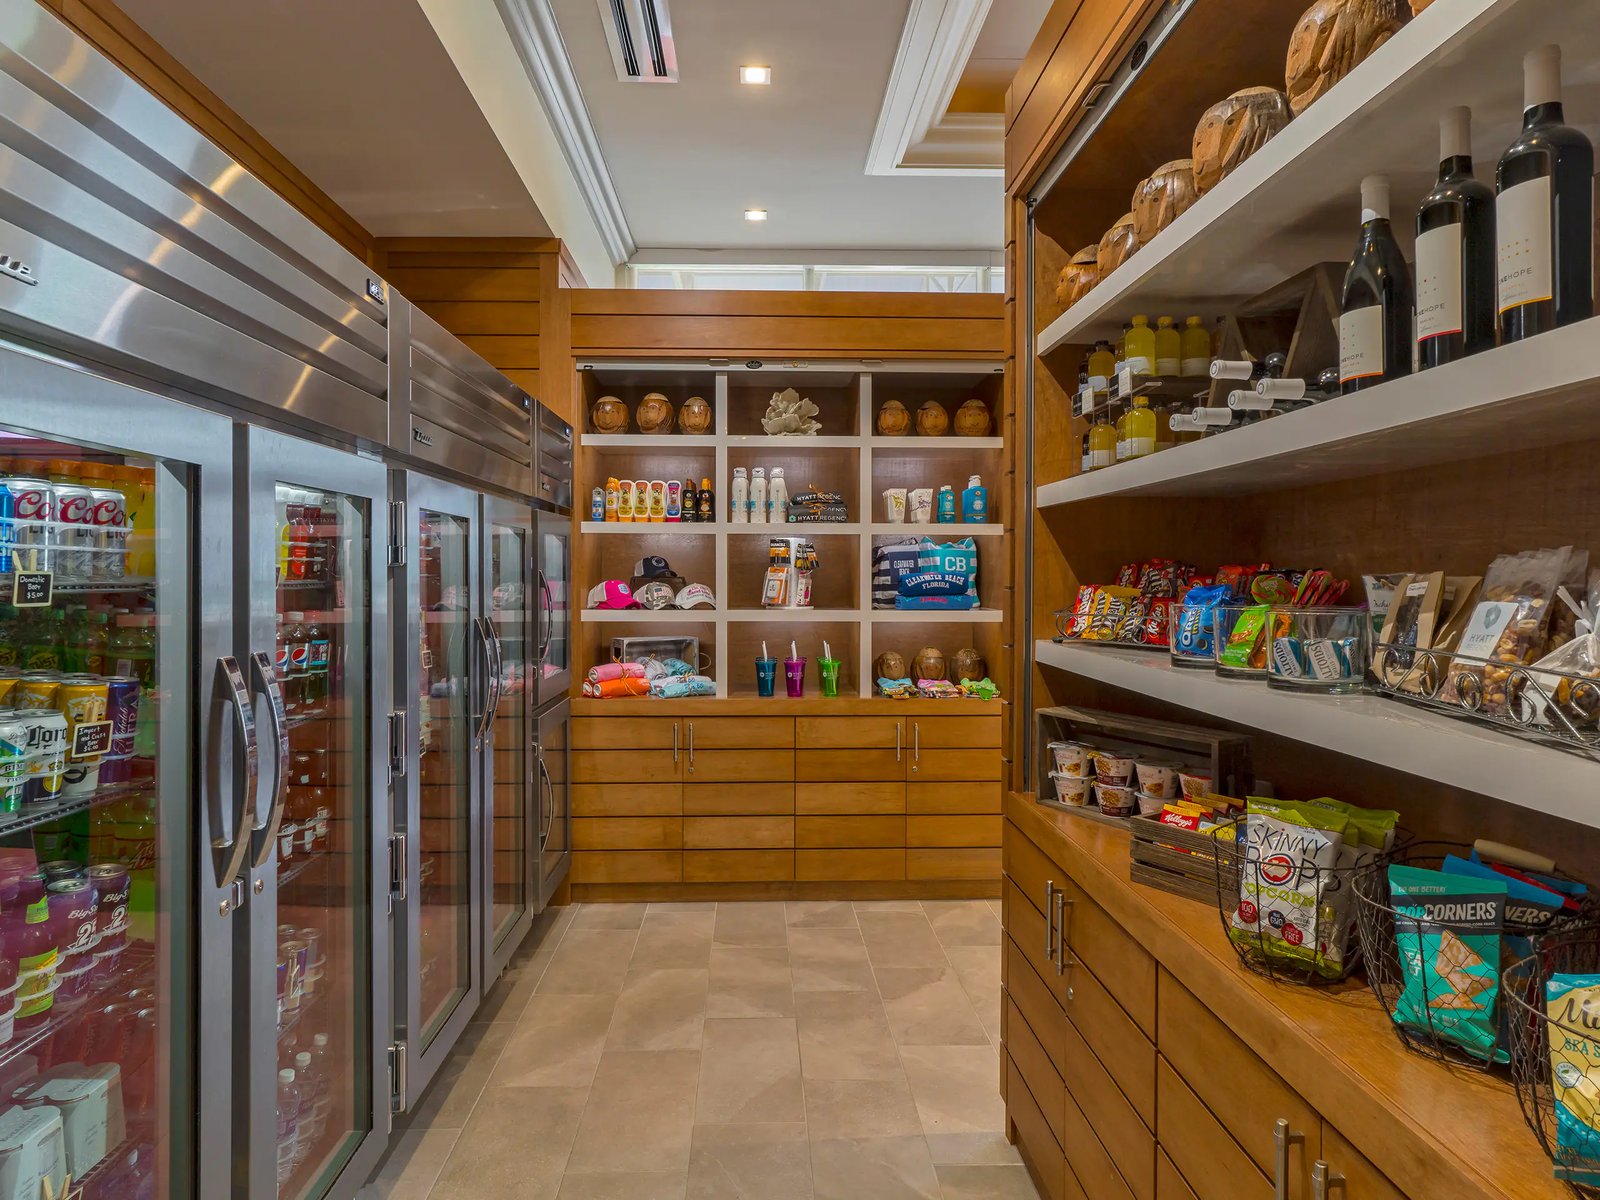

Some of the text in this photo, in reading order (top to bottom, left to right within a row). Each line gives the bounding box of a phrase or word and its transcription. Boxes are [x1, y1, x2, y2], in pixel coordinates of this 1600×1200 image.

[944, 556, 967, 572] CB
[905, 574, 965, 588] CLEARWATER BEACH
[922, 582, 950, 590] FLORIDA
[1469, 634, 1496, 642] HYATT
[1165, 813, 1193, 826] Kellogg's
[1284, 932, 1300, 944] FREE
[1564, 1037, 1590, 1056] SEA
